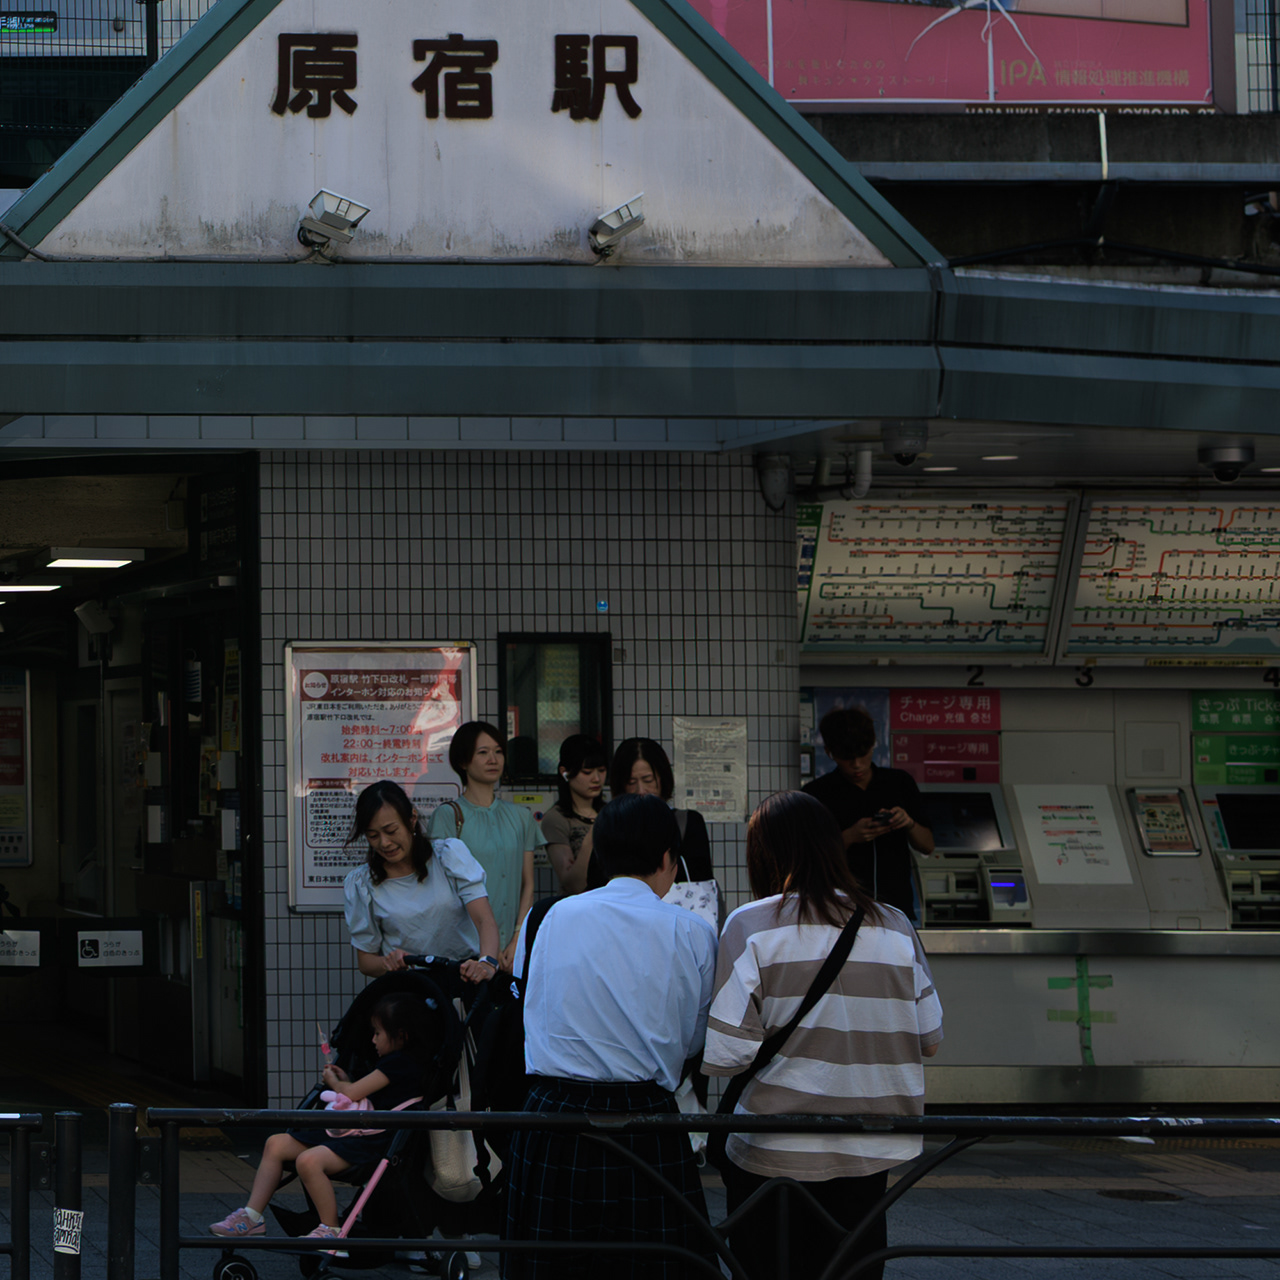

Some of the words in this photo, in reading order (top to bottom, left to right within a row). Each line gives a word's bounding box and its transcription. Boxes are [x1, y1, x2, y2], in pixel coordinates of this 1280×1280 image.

[271, 33, 642, 122] 原宿駅
[1000, 59, 1048, 86] IPA
[966, 665, 984, 686] 2
[1075, 665, 1094, 686] 3
[1263, 667, 1280, 687] 4
[900, 695, 991, 710] チャージ専用
[1199, 698, 1240, 711] きっぷ
[900, 712, 940, 724] Charge
[927, 742, 990, 754] チャージ専用
[926, 768, 956, 778] Charge
[308, 875, 345, 883] 東日本旅客
